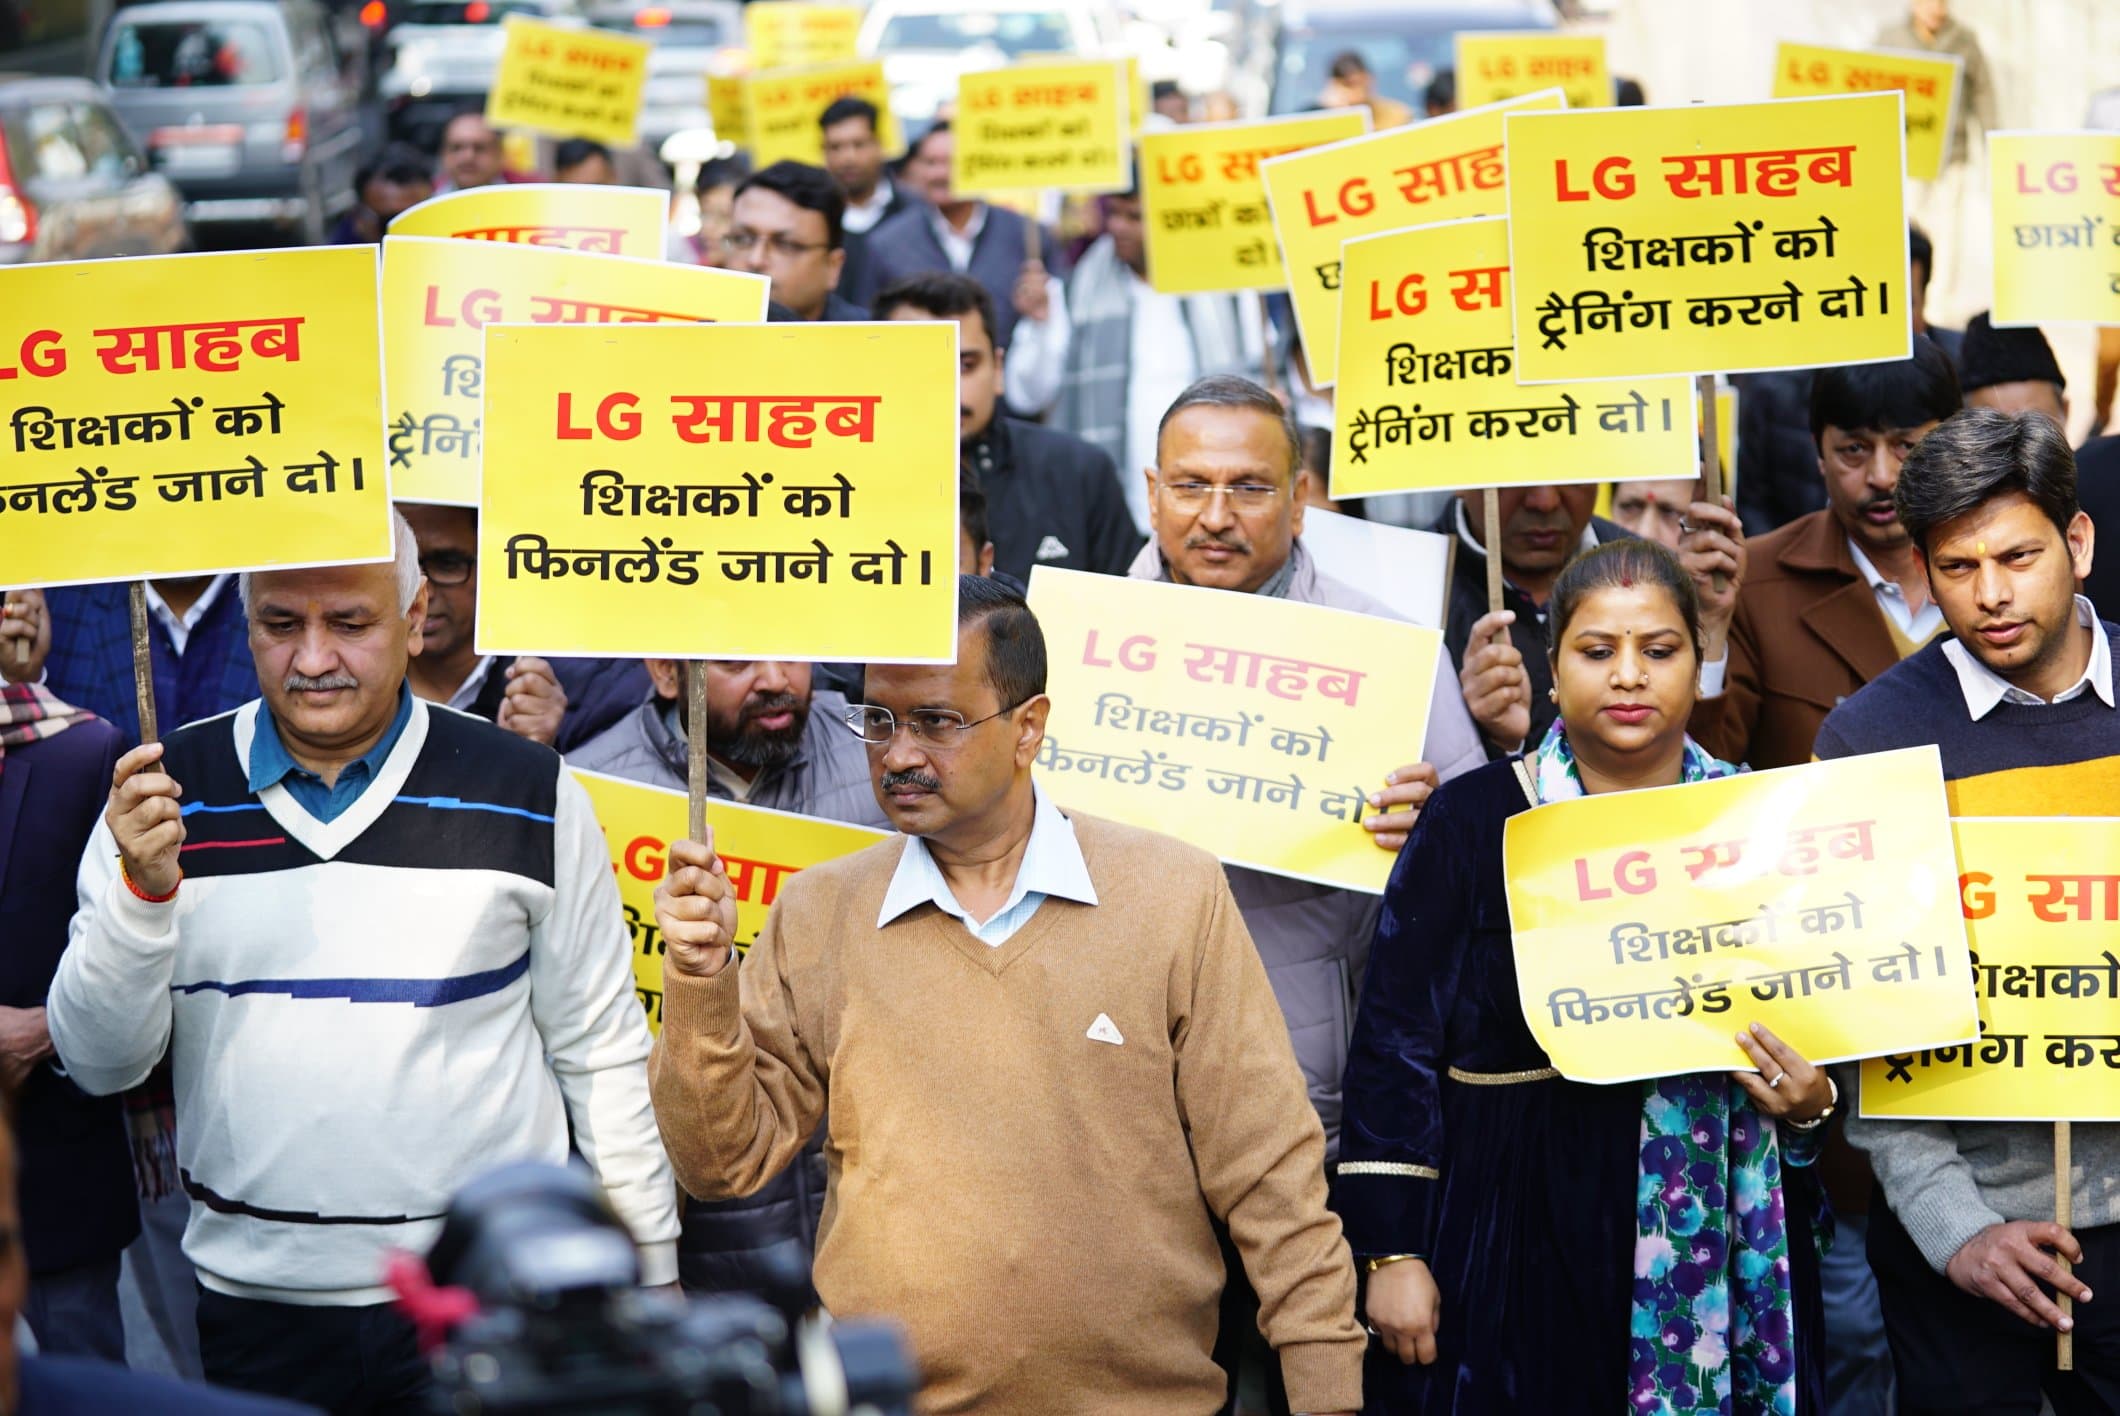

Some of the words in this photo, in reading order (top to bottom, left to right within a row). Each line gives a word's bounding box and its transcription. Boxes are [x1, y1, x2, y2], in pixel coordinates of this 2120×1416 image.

[1156, 153, 1205, 184] LG
[1304, 178, 1375, 227] LG
[1394, 144, 1504, 205] साह
[1556, 156, 1635, 202] LG
[1662, 146, 1856, 198] साहब
[2016, 162, 2078, 194] LG
[1582, 220, 1763, 271] शिक्षकों
[1773, 216, 1838, 258] को
[2014, 216, 2103, 248] छात्रों
[424, 285, 501, 329] LG
[1371, 274, 1427, 320] LG
[1536, 290, 1672, 350] ट्रैनिंग
[1686, 280, 1803, 327] करने
[1818, 275, 1888, 318] दो।
[93, 317, 305, 374] साहब
[1386, 343, 1512, 386] शिक्षक
[10, 397, 204, 452] शिक्षकों
[213, 392, 285, 436] को
[557, 392, 642, 441] LG
[671, 396, 882, 448] साहब
[1349, 404, 1454, 463] ट्रैनिंग
[1467, 394, 1580, 439] करने
[1596, 390, 1671, 432] दो।
[0, 466, 139, 514] नलेंड
[153, 455, 268, 502] जाने
[283, 450, 363, 493] दो।
[580, 470, 773, 517] शिक्षकों
[782, 473, 855, 518] को
[504, 534, 702, 585] फिनलेंड
[717, 539, 833, 584] जाने
[850, 540, 930, 585] दो।
[1082, 629, 1157, 672] LG
[1184, 643, 1367, 707] साहब
[1095, 693, 1264, 746] शिक्षकों
[1271, 726, 1333, 762] को
[1206, 769, 1306, 810] जाने
[610, 832, 665, 881] G
[1575, 851, 1657, 901] LG
[1799, 892, 1864, 934] को
[1958, 872, 1995, 920] G
[2026, 875, 2120, 922] सा
[1547, 976, 1732, 1027] फिनलेंड
[1747, 952, 1852, 1001] जाने
[1868, 942, 1946, 982] दो।
[2044, 1035, 2120, 1069] कर
